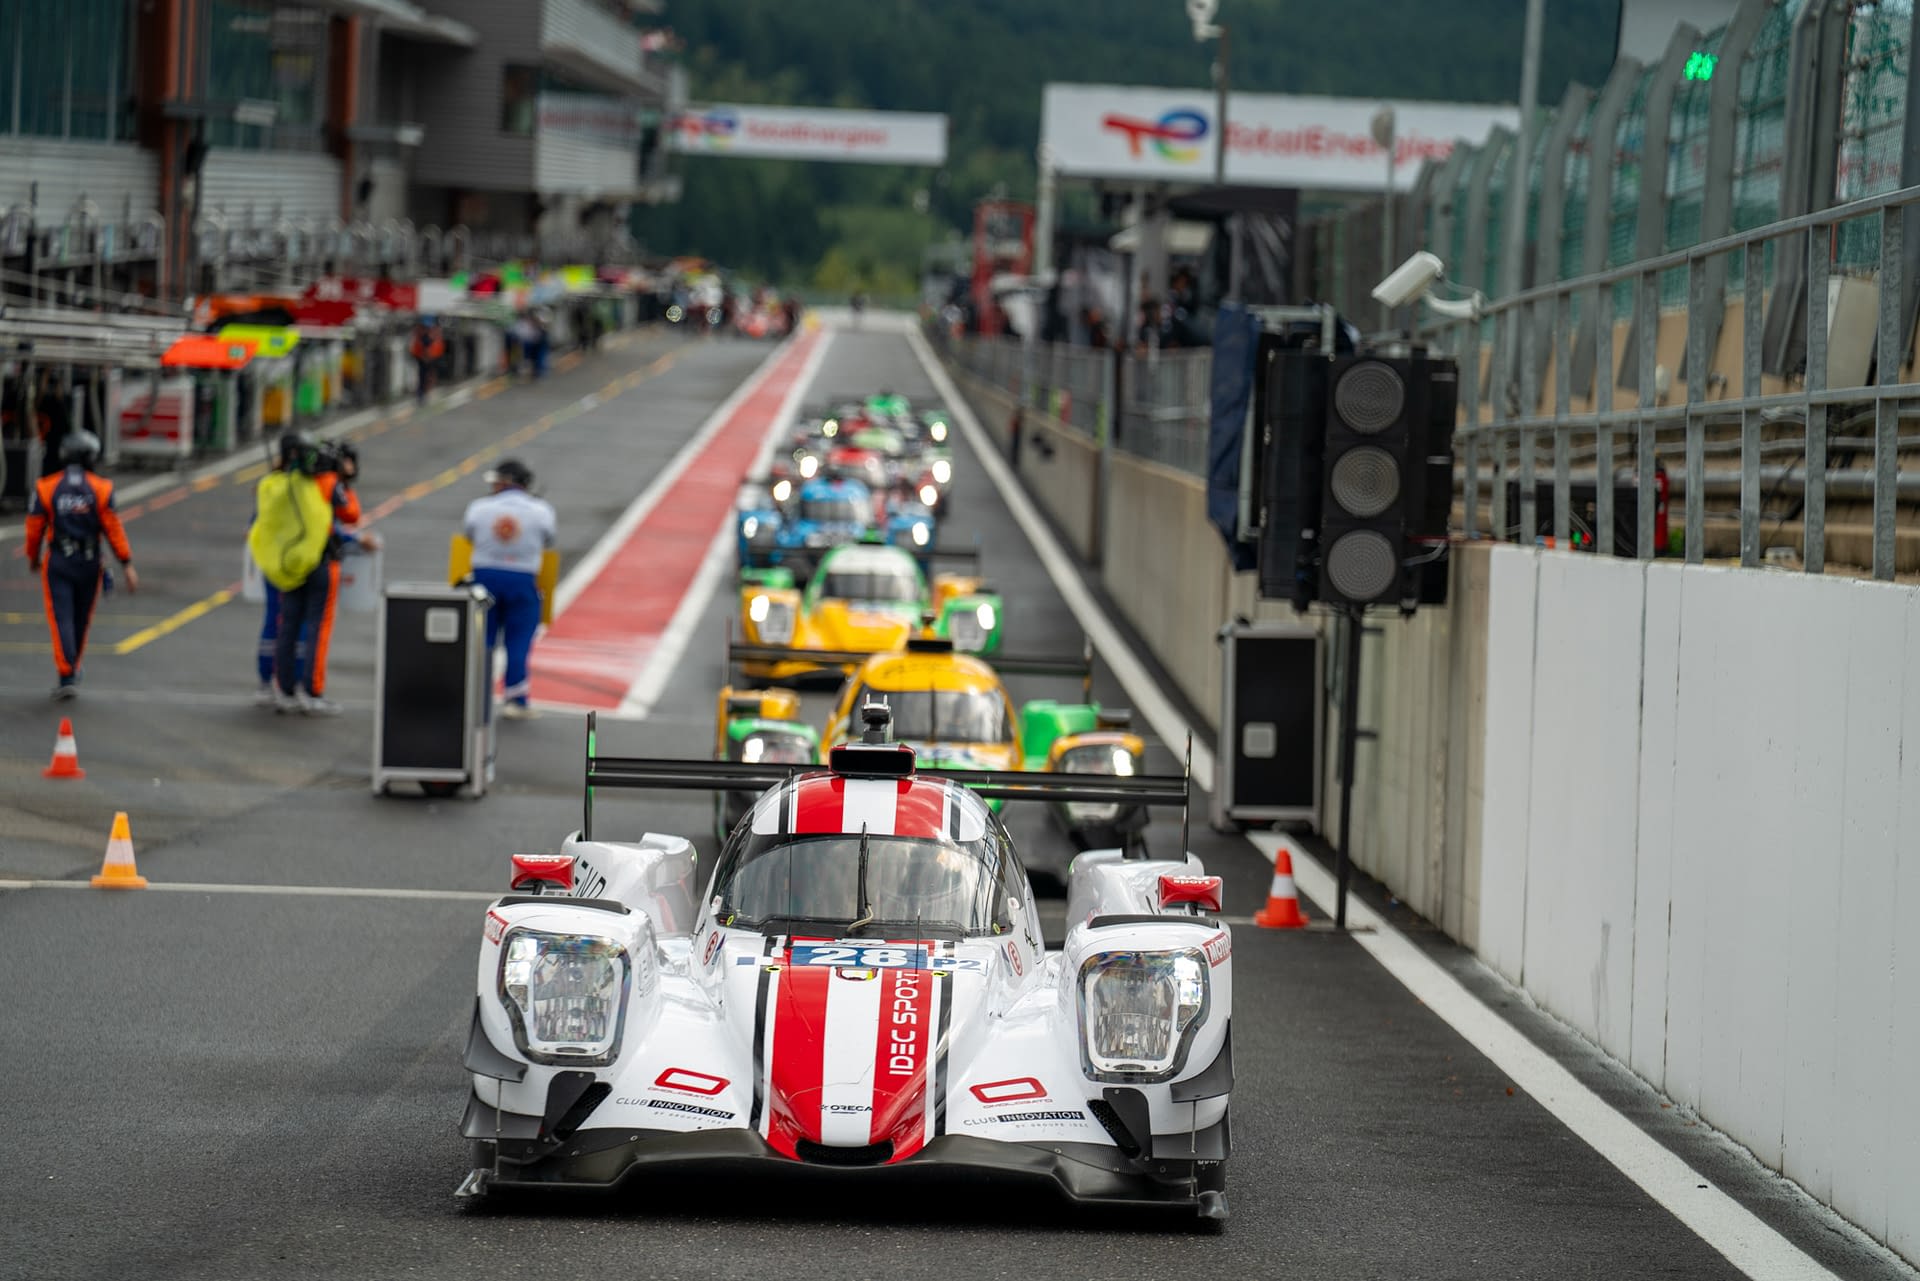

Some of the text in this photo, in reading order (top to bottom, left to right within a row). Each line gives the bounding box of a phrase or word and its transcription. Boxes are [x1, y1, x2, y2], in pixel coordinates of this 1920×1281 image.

[808, 946, 981, 971] 28 P2
[889, 970, 920, 1076] IDEC SPORT
[615, 1097, 649, 1107] CLUB
[650, 1100, 733, 1119] INNOVATION
[963, 1111, 1082, 1127] CLUB INNOVATION
